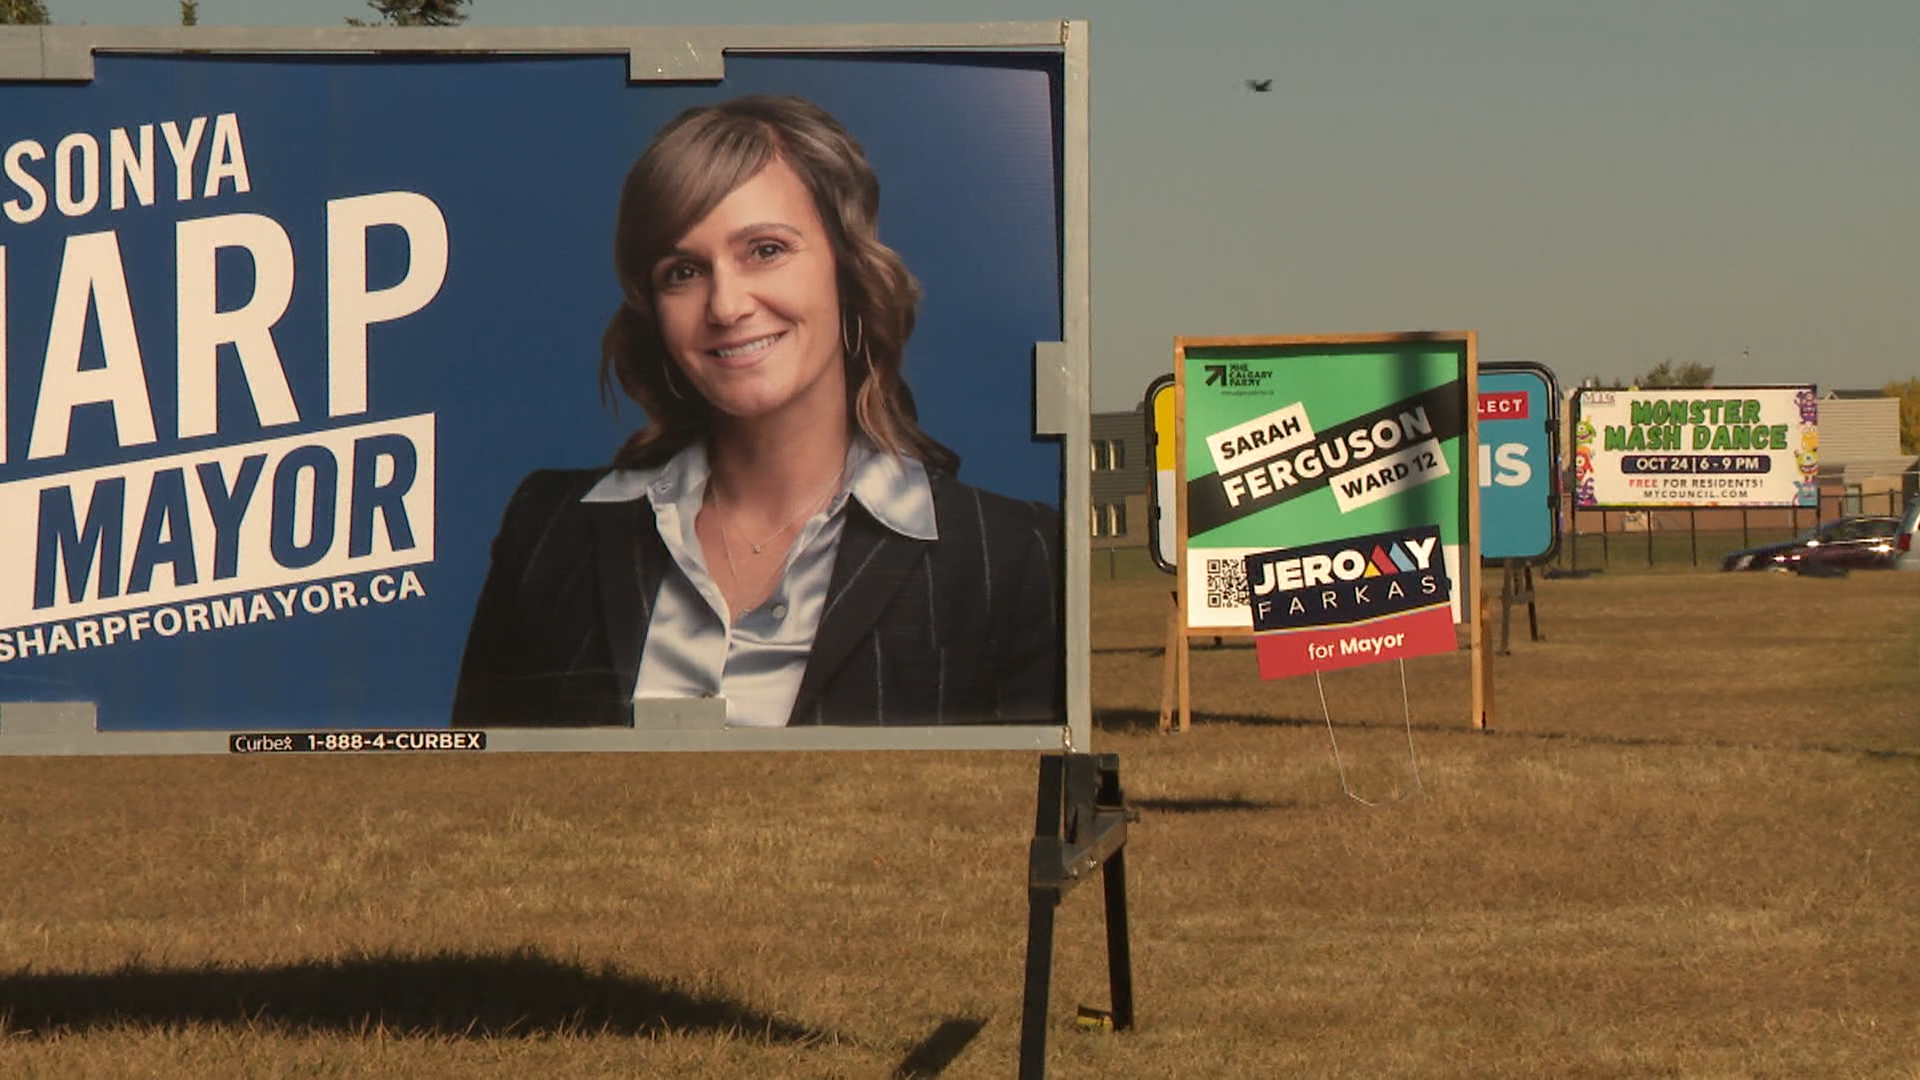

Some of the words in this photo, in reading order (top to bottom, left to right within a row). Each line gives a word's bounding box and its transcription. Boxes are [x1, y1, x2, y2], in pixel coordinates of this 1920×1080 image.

[2, 112, 251, 224] SONYA
[0, 190, 449, 464] ARP
[1631, 399, 1760, 425] MONSTER
[1220, 415, 1301, 460] SARAH
[1222, 406, 1432, 508] FERGUSON
[1604, 425, 1682, 451] MASH
[1692, 424, 1788, 450] DANCE
[1341, 463, 1409, 498] WARD
[1412, 452, 1437, 473] 12
[1629, 479, 1658, 488] FREE
[1663, 479, 1687, 488] FOR
[1692, 479, 1763, 488] RESIDENTS!
[1636, 458, 1668, 470] OCT
[1671, 458, 1688, 470] 24
[1700, 458, 1710, 470] 6
[1722, 458, 1732, 470] 9
[1736, 458, 1759, 470] PM
[32, 433, 417, 610] MAYOR
[0, 570, 427, 662] SHARPFORMAYOR.CA
[1257, 575, 1436, 620] FARKAS
[1308, 643, 1335, 660] for
[1340, 632, 1405, 655] Mayor
[235, 735, 293, 752] Curbex
[307, 733, 481, 750] 1-888-4-CURBEX
